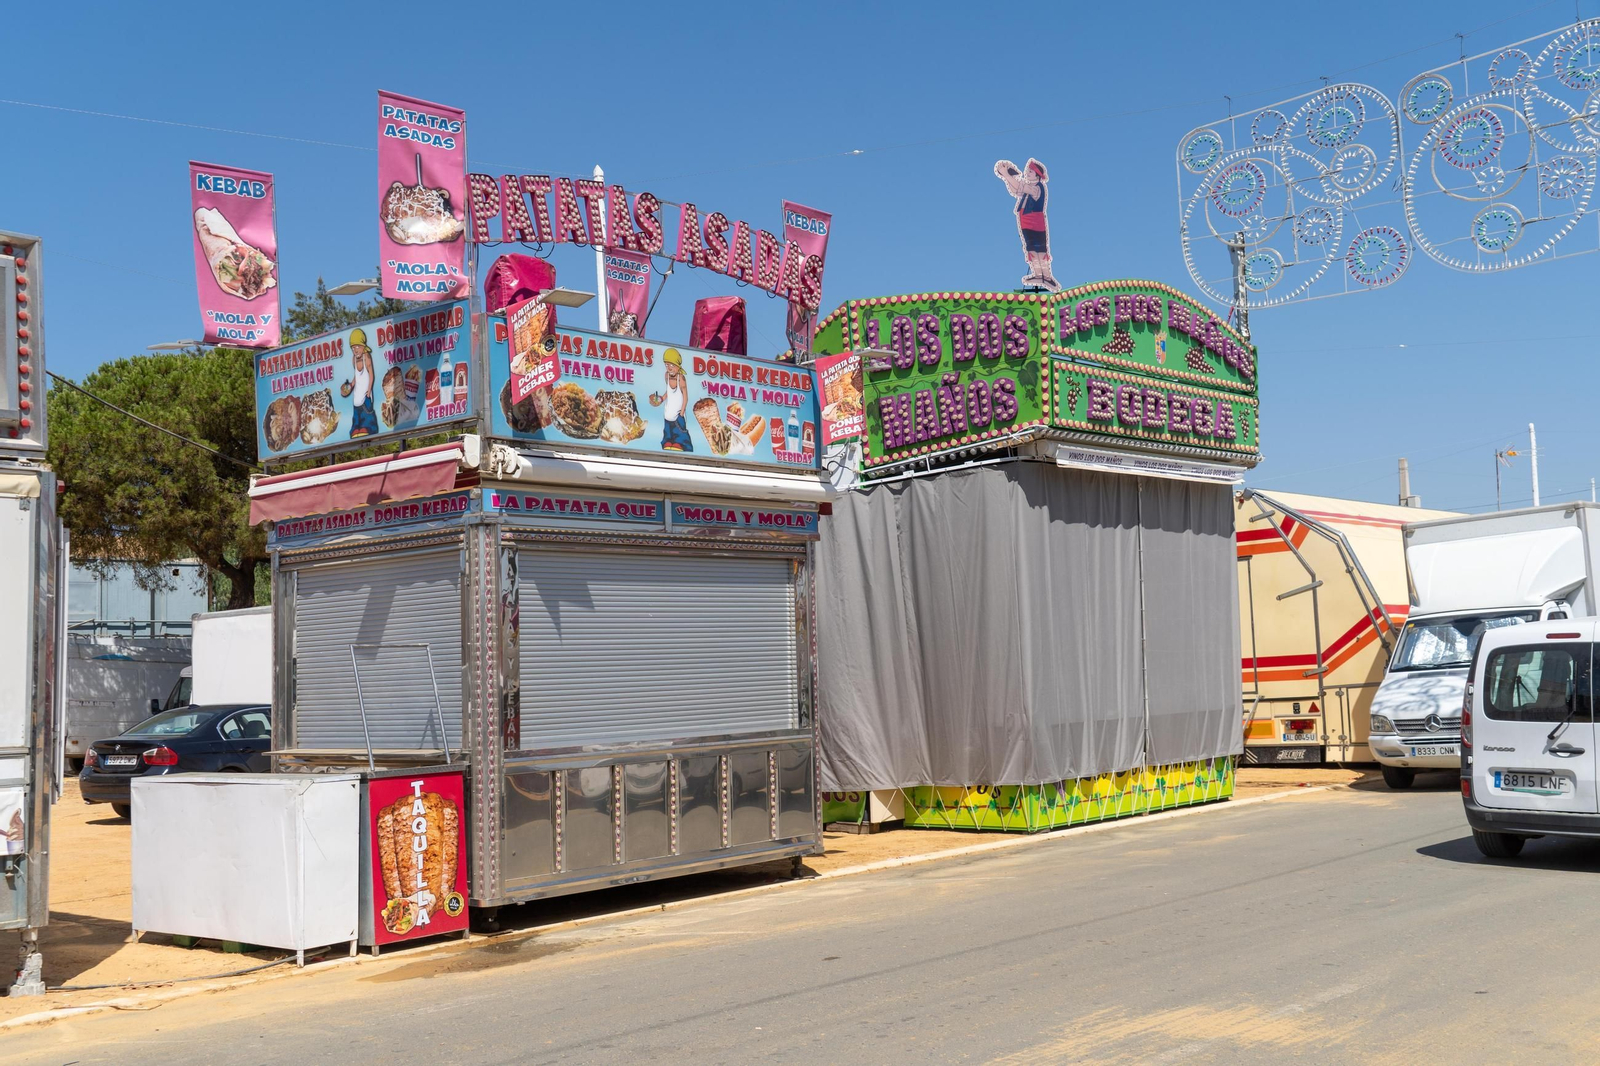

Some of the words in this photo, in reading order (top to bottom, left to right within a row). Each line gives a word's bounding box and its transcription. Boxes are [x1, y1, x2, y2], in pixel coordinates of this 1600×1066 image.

[382, 104, 462, 133] PATATAS
[384, 124, 456, 150] ASADAS
[196, 173, 267, 199] KEBAB
[785, 210, 827, 236] KEBAB
[466, 172, 664, 255] PATATAS
[676, 202, 824, 311] ASADAS
[388, 260, 449, 276] "MOLA
[605, 255, 649, 273] PATATAS
[607, 269, 645, 285] ASADAS
[396, 279, 457, 294] MOLA"
[207, 309, 256, 326] "MOLA
[260, 313, 272, 325] Y
[376, 320, 418, 347] DÖNER
[421, 306, 464, 336] KEBAB
[217, 327, 264, 342] MOLA"
[866, 313, 942, 372] LOS
[950, 312, 1030, 362] DOS
[1058, 295, 1111, 340] LOS
[1114, 293, 1163, 325] DOS
[1167, 299, 1255, 379] MAÑOS
[259, 348, 304, 378] PATATAS
[304, 338, 344, 365] ASADAS
[384, 346, 415, 365] "MOLA
[416, 343, 424, 358] Y
[425, 332, 459, 357] MOLA"
[586, 337, 654, 367] ASADAS
[271, 379, 283, 394] LA
[283, 370, 316, 392] PATATA
[316, 365, 334, 385] QUE
[518, 360, 554, 388] DONER
[604, 366, 635, 385] QUE
[692, 355, 754, 383] DÖNER
[757, 367, 813, 392] KEBAB
[821, 370, 828, 379] LA
[828, 360, 848, 376] PATATA
[519, 371, 556, 397] KEBAB
[701, 379, 747, 402] "MOLA
[749, 387, 760, 402] Y
[762, 388, 806, 410] MOLA"
[426, 399, 468, 422] BEBIDAS
[878, 371, 1019, 450] MAÑOS
[1086, 378, 1238, 440] BODEGA
[776, 449, 813, 466] BEBIDAS
[1068, 452, 1084, 460] VINOS
[1084, 454, 1094, 462] LOS
[1094, 455, 1106, 463] DOS
[1105, 455, 1123, 466] MAÑOS
[277, 517, 324, 538] PATATAS
[325, 510, 366, 532] ASADAS
[374, 504, 420, 524] DÖNER
[421, 496, 469, 517] KEBAB
[491, 493, 522, 510] LA
[523, 495, 611, 517] PATATA
[615, 502, 657, 520] QUE
[676, 505, 738, 525] "MOLA
[740, 511, 755, 525] Y
[757, 512, 814, 529] MOLA"
[1417, 747, 1437, 755] 8333
[1503, 774, 1536, 788] 6815
[1540, 776, 1567, 790] LNF
[410, 780, 430, 927] TAQUILLA
